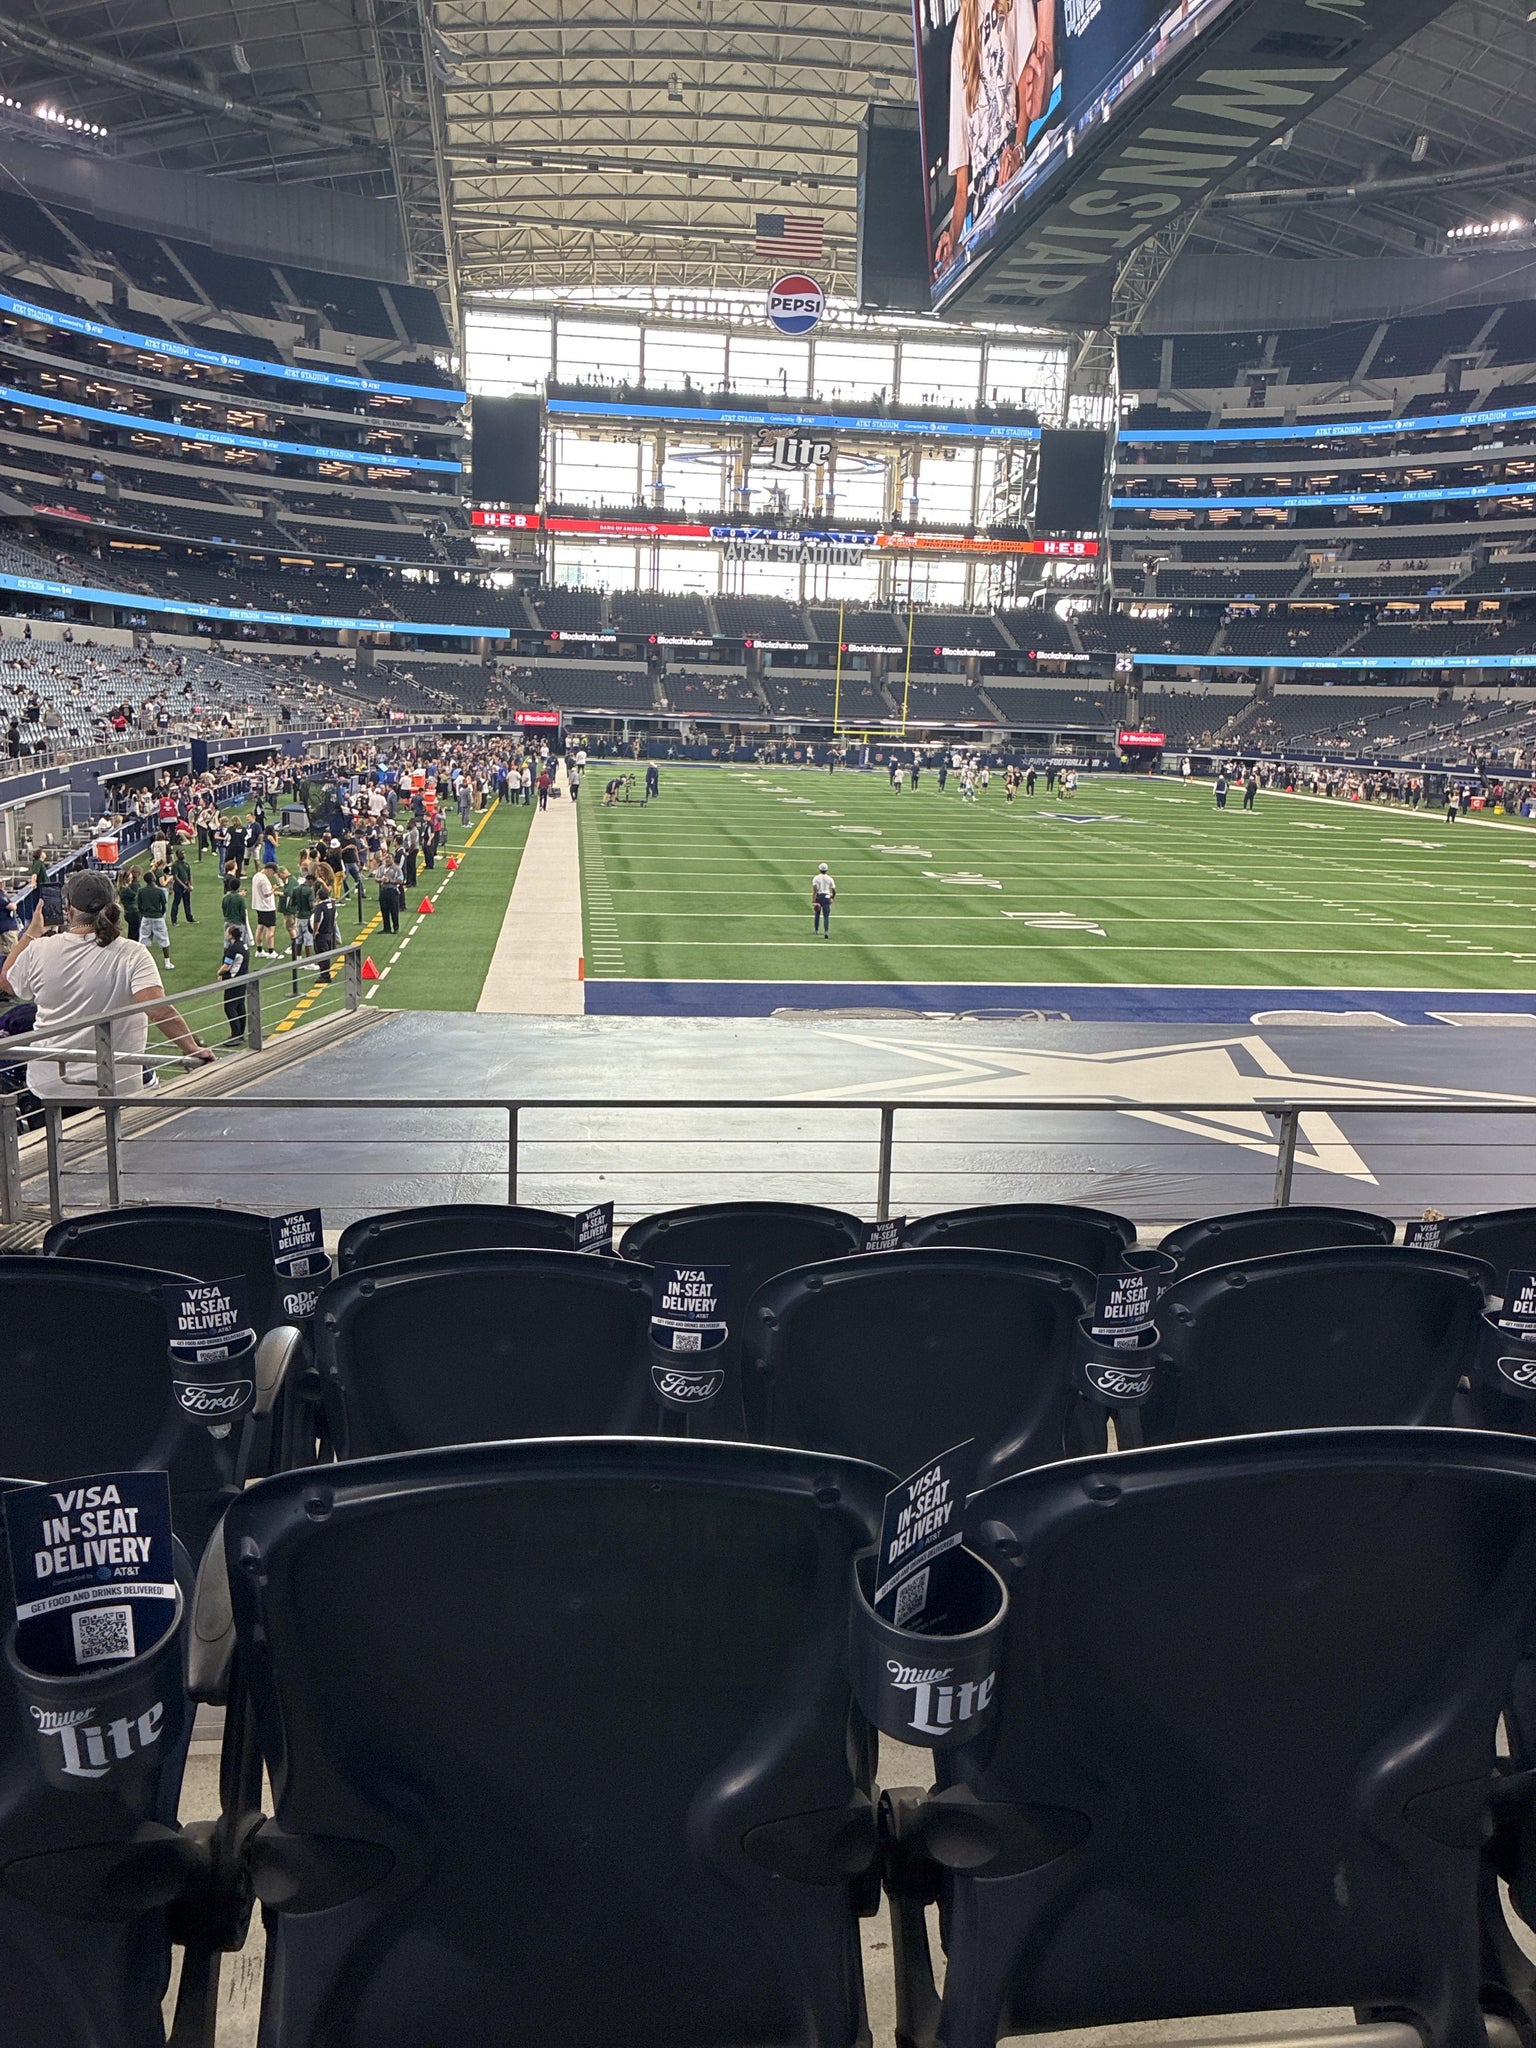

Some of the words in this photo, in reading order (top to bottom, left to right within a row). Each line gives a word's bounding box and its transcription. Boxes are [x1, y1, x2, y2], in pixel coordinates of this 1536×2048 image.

[984, 67, 1349, 296] WINSTAR
[771, 298, 820, 313] PEPSI
[12, 303, 26, 317] AT&T
[27, 308, 54, 323] STADIUM
[92, 326, 104, 334] AT&T
[145, 339, 160, 349] AT&T
[161, 342, 190, 356] STADIUM
[228, 358, 240, 366] AT&T
[284, 368, 299, 378] AT&T
[300, 371, 330, 383] STADIUM
[721, 414, 736, 422] AT&T
[736, 415, 765, 424] STADIUM
[872, 421, 899, 429] STADIUM
[1460, 415, 1476, 424] AT&T
[1478, 412, 1507, 422] STADIUM
[1006, 428, 1032, 437] STADIUM
[1332, 426, 1362, 434] STADIUM
[196, 432, 210, 441] AT&T
[212, 434, 235, 444] STADIUM
[315, 448, 330, 456] AT&T
[330, 450, 354, 460] STADIUM
[771, 437, 830, 471] Lite
[778, 531, 800, 540] 81:20
[725, 544, 774, 562] AT&T
[777, 547, 862, 566] STADIUM
[560, 632, 616, 642] Blockchain.com
[657, 636, 713, 646] Blockchain.com
[753, 640, 808, 650] Blockchain.com
[849, 644, 902, 654] Blockchain.com
[942, 648, 996, 658] Blockchain.com
[1036, 652, 1090, 661] Blockchain.com
[1117, 658, 1132, 672] 25
[283, 1215, 304, 1226] VISA
[586, 1208, 602, 1220] VISA
[281, 1222, 311, 1238] IN-SEAT
[582, 1215, 606, 1232] IN-SEAT
[876, 1222, 894, 1232] VISA
[1420, 1224, 1438, 1232] VISA
[579, 1224, 608, 1242] DELIVERY
[870, 1228, 898, 1241] IN-SEAT
[1414, 1230, 1440, 1242] IN-SEAT
[279, 1232, 316, 1250] DELIVERY
[866, 1237, 898, 1250] DELIVERY
[1410, 1240, 1440, 1249] DELIVERY
[674, 1270, 706, 1282] VISA
[1118, 1276, 1144, 1290] VISA
[185, 1286, 221, 1300] VISA
[668, 1281, 714, 1297] IN-SEAT
[1111, 1287, 1148, 1304] IN-SEAT
[298, 1291, 315, 1304] Dr
[662, 1296, 718, 1312] DELIVERY
[182, 1296, 230, 1316] IN-SEAT
[1104, 1300, 1150, 1318] DELIVERY
[178, 1310, 238, 1330] DELIVERY
[218, 1326, 232, 1334] AT&T
[660, 1372, 715, 1397] Ford
[1098, 1370, 1150, 1392] Ford
[182, 1386, 240, 1410] Ford
[908, 1465, 940, 1502] VISA
[50, 1484, 120, 1512] VISA
[897, 1480, 950, 1534] IN-SEAT
[43, 1508, 138, 1546] IN-SEAT
[889, 1500, 954, 1565] DELIVERY
[924, 1530, 941, 1546] AT&T
[34, 1537, 152, 1578] DELIVERY
[114, 1566, 140, 1577] AT&T
[901, 1567, 910, 1577] AND
[31, 1602, 46, 1614] GET
[48, 1596, 70, 1608] FOOD
[73, 1591, 90, 1602] AND
[92, 1586, 122, 1598] DRINKS
[124, 1586, 164, 1595] DELIVERED!
[886, 1660, 954, 1684] Miller
[891, 1670, 996, 1736] Lite
[30, 1705, 96, 1730] Miller
[50, 1701, 164, 1778] Lite
